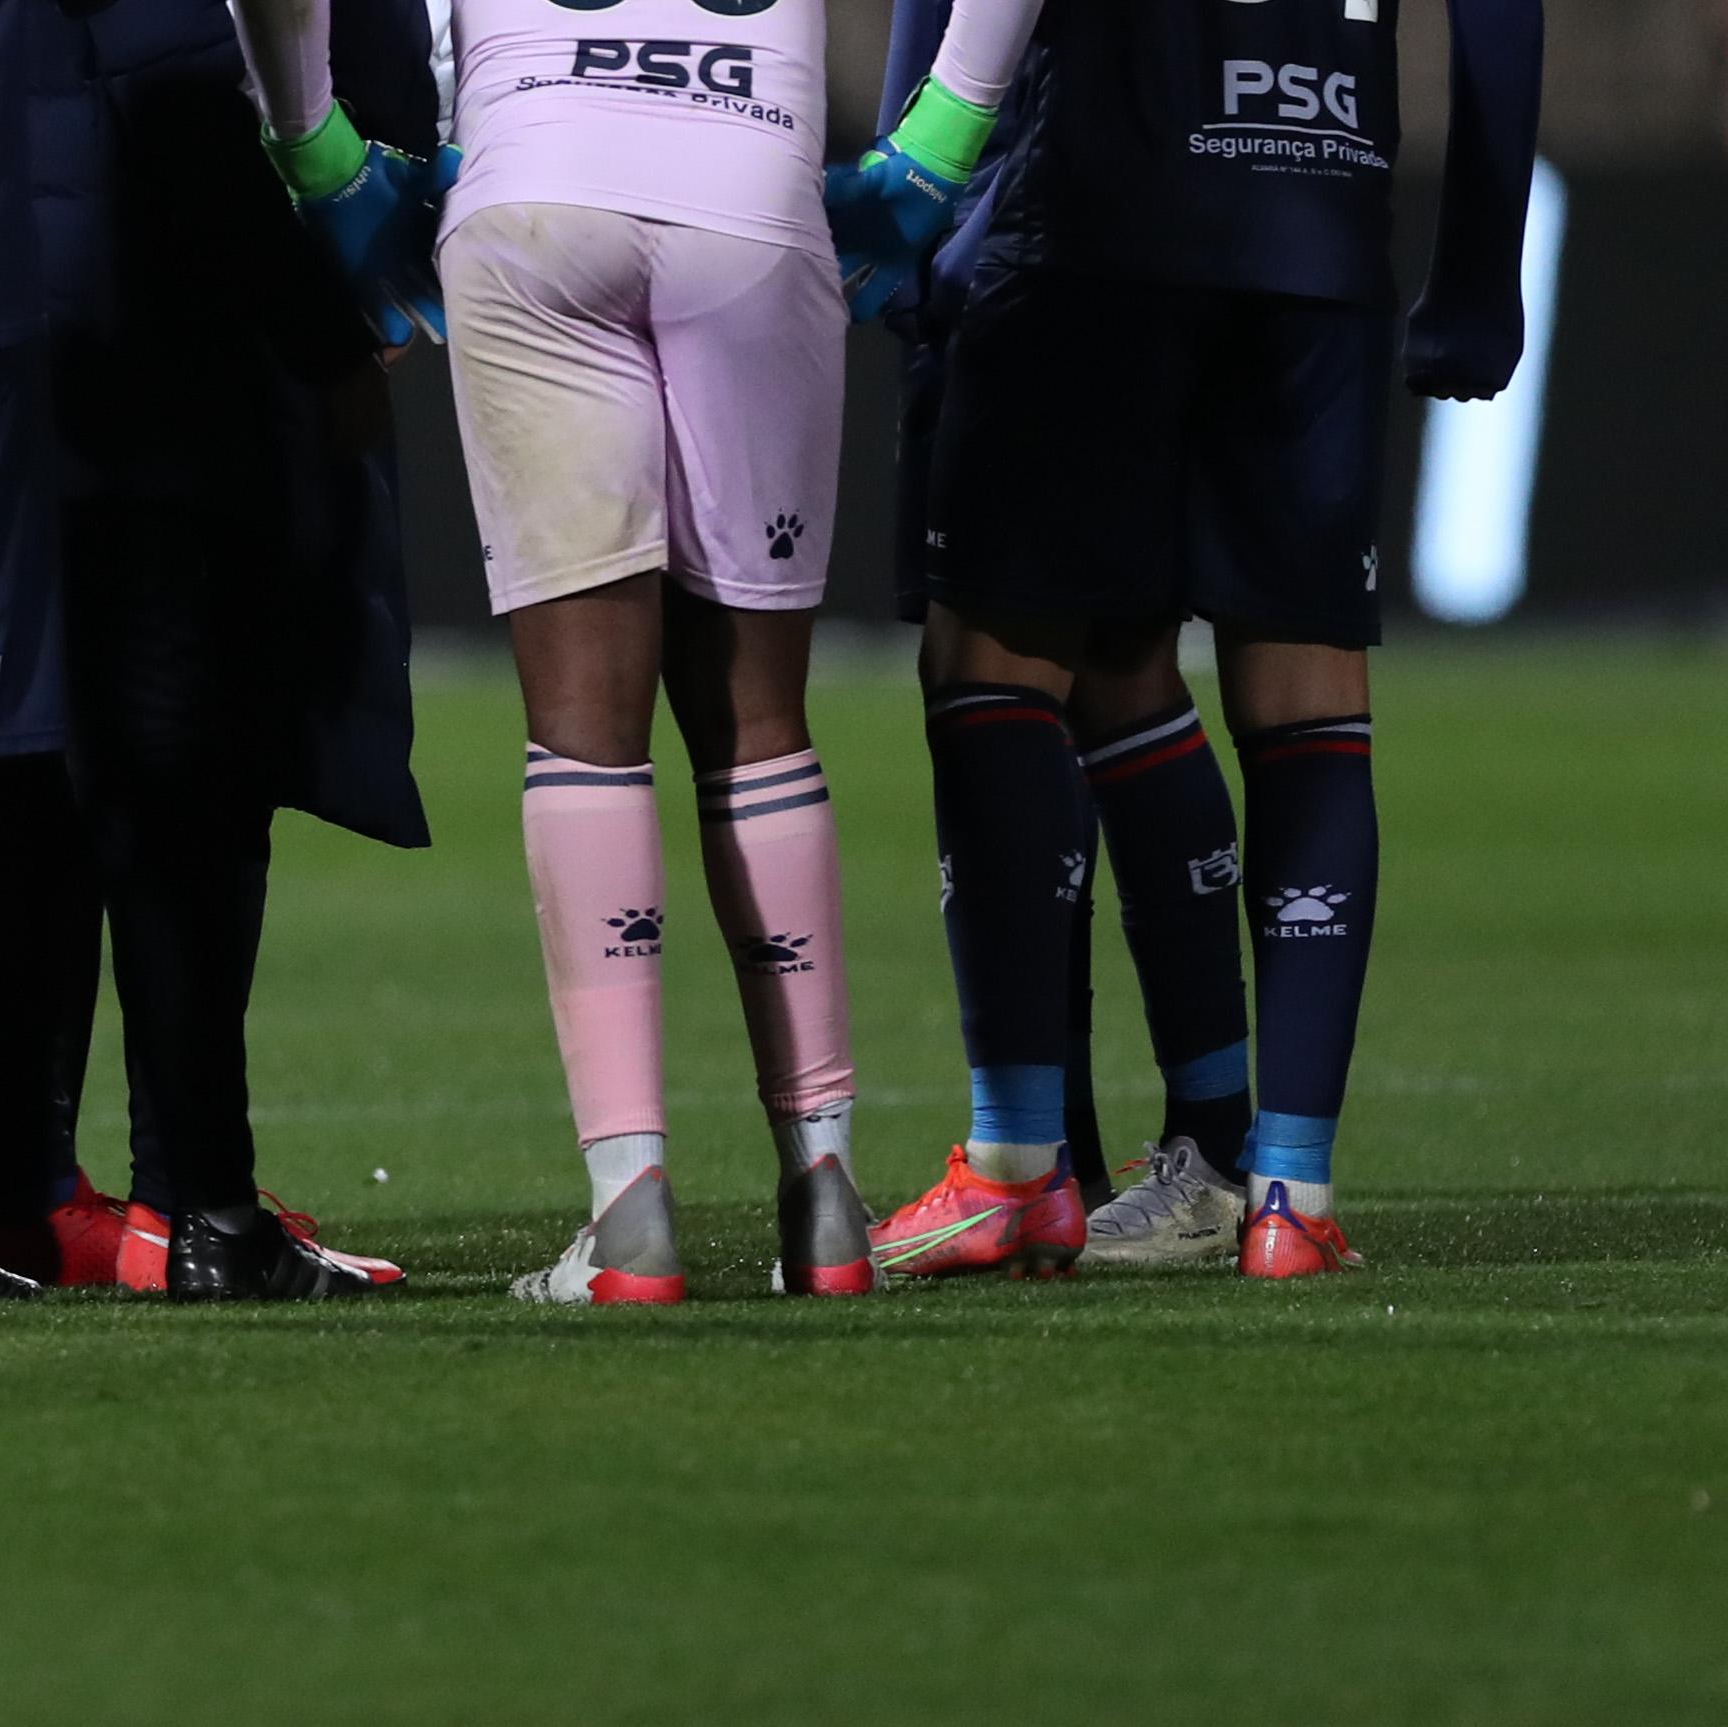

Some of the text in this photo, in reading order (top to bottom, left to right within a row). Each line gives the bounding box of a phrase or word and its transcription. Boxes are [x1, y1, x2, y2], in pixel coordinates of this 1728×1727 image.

[571, 40, 753, 98] PSG
[1223, 60, 1359, 129] PSG
[1189, 133, 1389, 169] Segurança Privada
[1263, 923, 1347, 938] KELME
